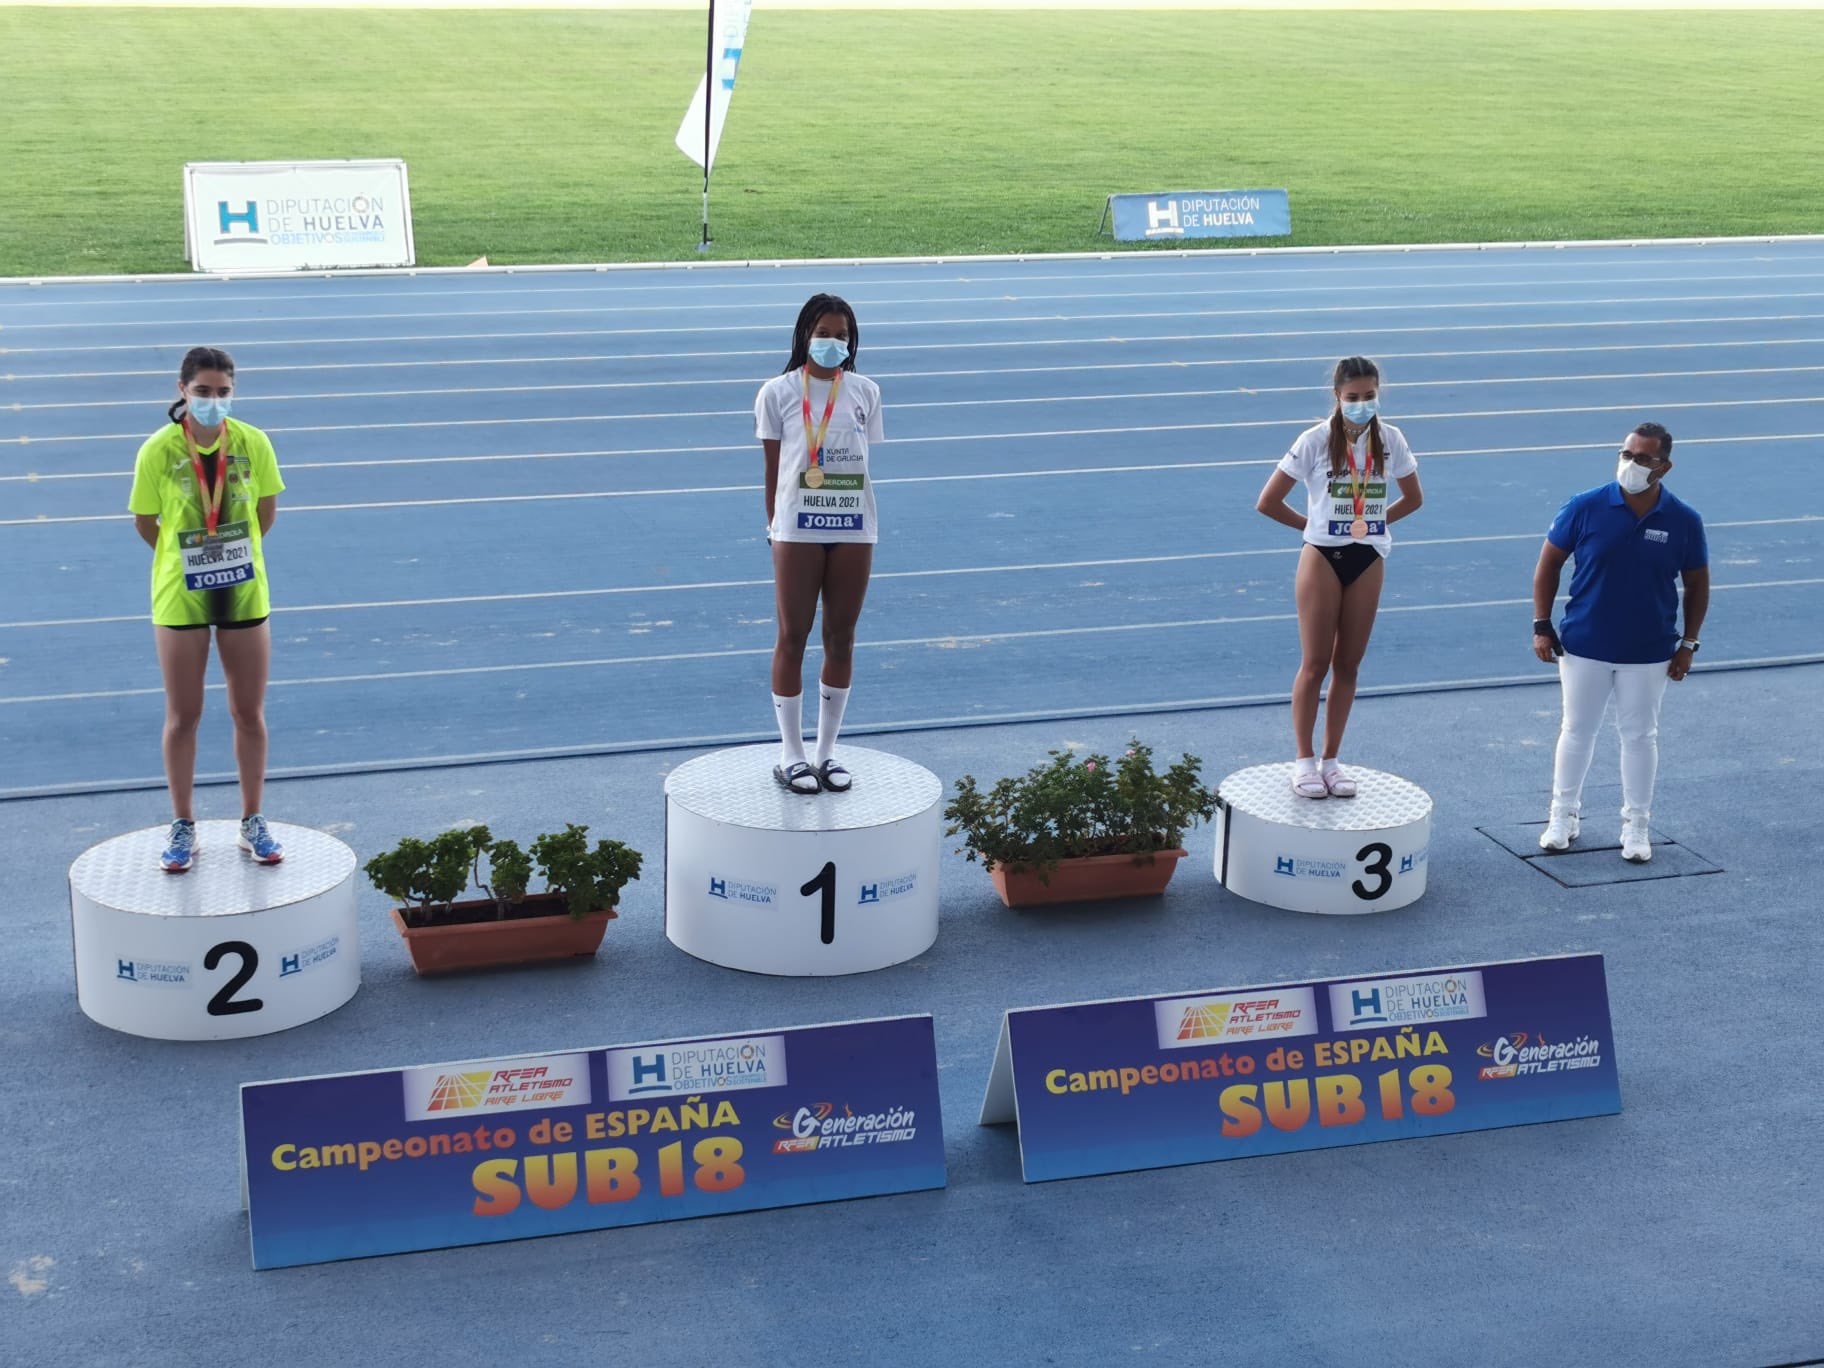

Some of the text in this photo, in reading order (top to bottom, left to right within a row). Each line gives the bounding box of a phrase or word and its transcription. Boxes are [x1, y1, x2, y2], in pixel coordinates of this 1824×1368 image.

[266, 192, 384, 215] DIPUTACIÓN
[1182, 196, 1260, 213] DIPUTACIÓN
[218, 201, 259, 234] H
[1148, 200, 1179, 228] H
[1183, 212, 1254, 227] DE HUELVA
[269, 215, 384, 233] DE HUELVA
[271, 231, 343, 245] OBJETIVOS
[803, 495, 860, 508] HUELVA 2021
[1365, 504, 1383, 515] 2021
[226, 546, 248, 561] 2021
[1296, 859, 1346, 870] DIPUTACIÓN
[1296, 867, 1341, 878] DE HUELVA
[1352, 842, 1393, 900] 3
[728, 880, 776, 895] DIPUTACIÓN
[728, 889, 771, 903] DE HUELVA
[880, 882, 914, 897] DE HUELVA
[800, 861, 836, 944] 1
[137, 962, 190, 974] DIPUTACIÓN
[303, 958, 311, 968] DE
[138, 972, 185, 983] DE HUELVA
[204, 940, 263, 1016] 2
[1385, 977, 1467, 998] DIPUTACIÓN
[1233, 999, 1280, 1014] RFEA
[1352, 988, 1382, 1016] H
[1387, 993, 1468, 1012] DE HUELVA
[1229, 1009, 1301, 1024] ATLETISMO
[1389, 1009, 1440, 1022] OBJETIVOS
[1226, 1021, 1296, 1036] AIRE LIBRE
[671, 1041, 766, 1065] DIPUTACIÓN
[1493, 1035, 1600, 1066] Generación
[632, 1054, 665, 1084] H
[1045, 1026, 1449, 1095] Campeonato de ESPAÑA
[1517, 1056, 1600, 1075] ATLETISMO
[493, 1066, 549, 1082] RFEA
[673, 1059, 766, 1080] DE HUELVA
[489, 1078, 573, 1094] ATLETISMO
[674, 1076, 733, 1090] OBJETIVOS
[484, 1091, 565, 1106] AIRE LIBRE
[1219, 1064, 1456, 1138] SUB 18
[792, 1106, 916, 1139] Generación
[271, 1096, 740, 1171] Campeonato de ESPAÑA
[818, 1128, 916, 1149] ATLETISMO
[472, 1136, 745, 1217] SUB 18
